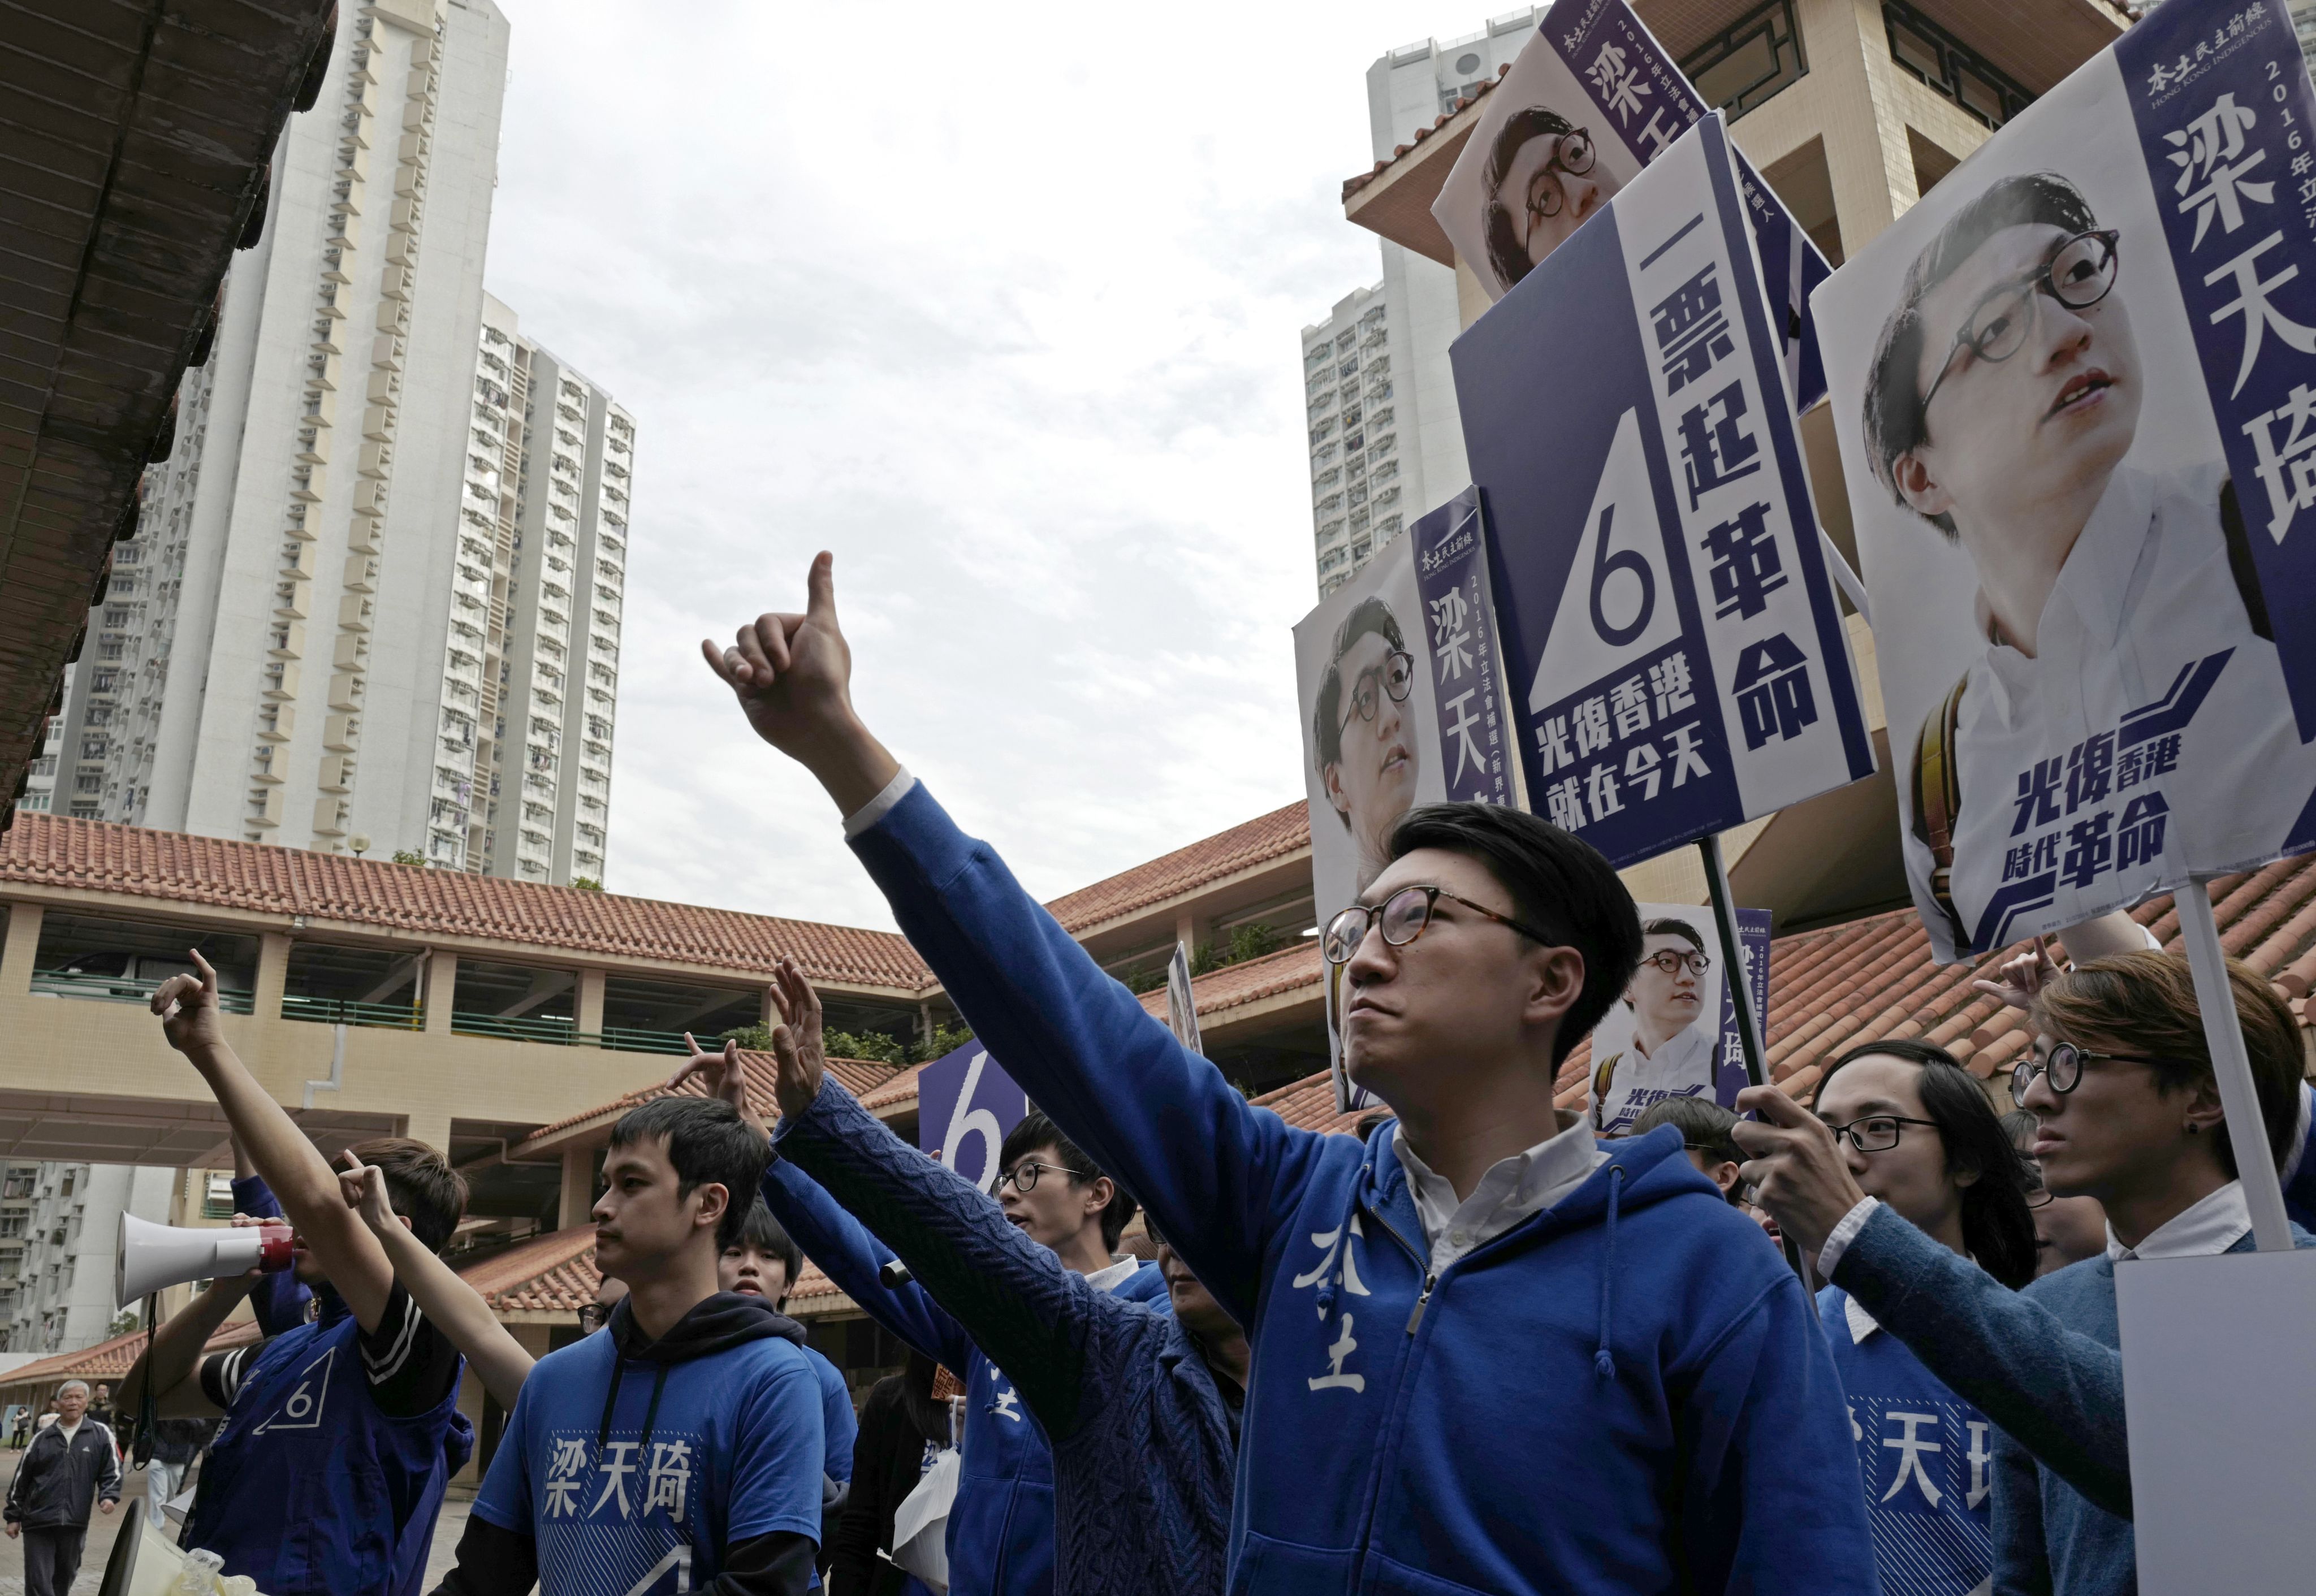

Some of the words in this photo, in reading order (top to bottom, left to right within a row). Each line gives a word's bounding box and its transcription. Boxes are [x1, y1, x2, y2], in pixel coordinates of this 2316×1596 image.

[1563, 0, 1603, 53] 本土民主前
[2148, 1, 2267, 97] 本土民主前線
[2152, 85, 2181, 110] HONG
[2182, 63, 2211, 87] KONG
[2213, 17, 2272, 65] INDIGENOUS
[1639, 212, 1818, 752] 一票起革命
[1422, 531, 1474, 572] 本土民主前線
[1424, 570, 1437, 582] HONG
[1437, 563, 1450, 573] KONG
[1449, 546, 1476, 565] INDIGENOUS
[1589, 502, 1656, 647] 6
[1429, 586, 1489, 803] 梁天
[1535, 651, 1697, 777] 光復香港
[1545, 720, 1712, 833] 就在今天
[2010, 729, 2182, 838] 光復香港
[2001, 790, 2171, 890] 時代革命
[941, 1049, 1001, 1196] 6
[1293, 1212, 1371, 1394] 本土
[286, 1381, 312, 1418] 6
[543, 1437, 693, 1523] 梁天琦
